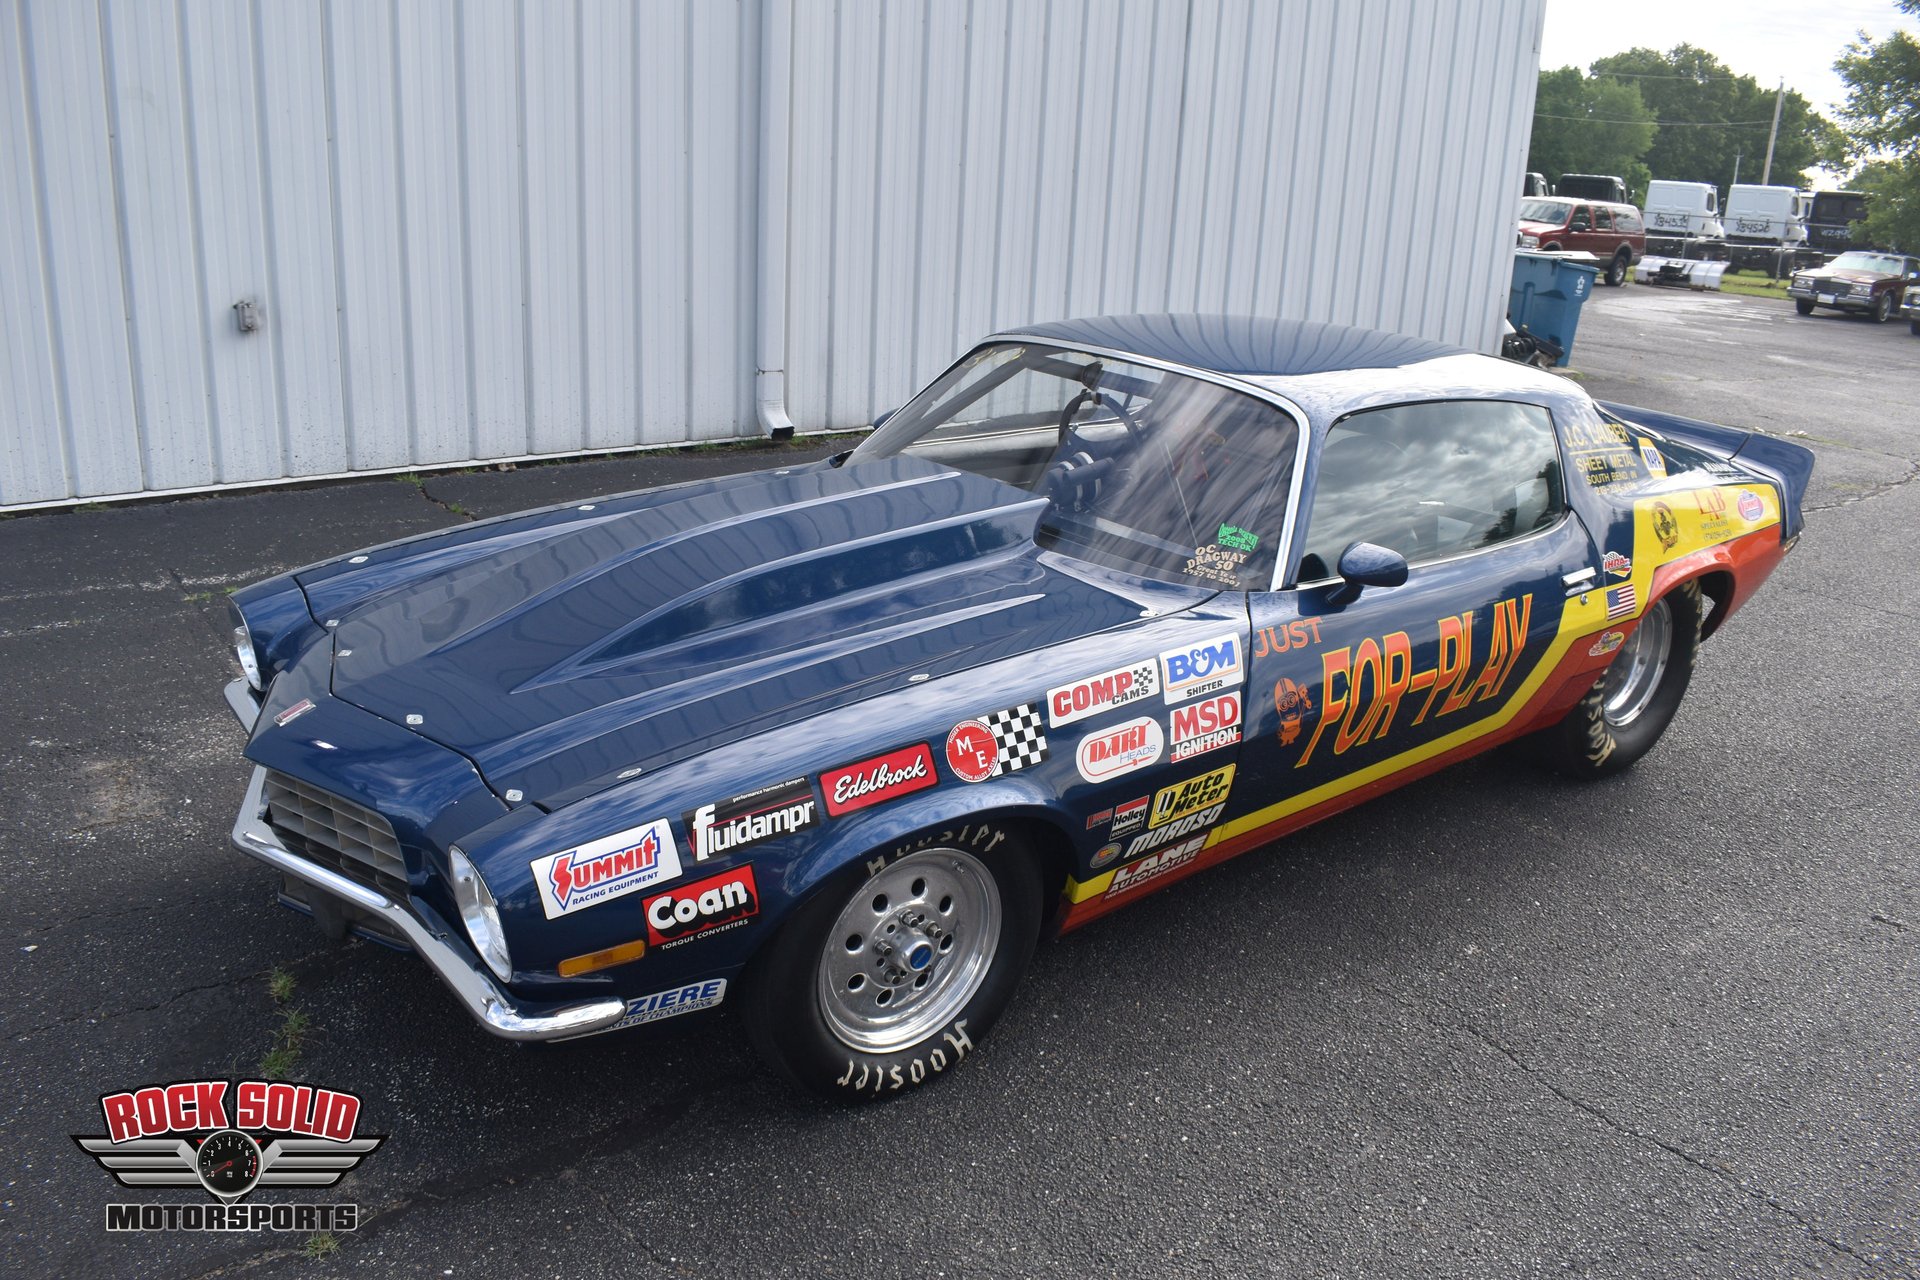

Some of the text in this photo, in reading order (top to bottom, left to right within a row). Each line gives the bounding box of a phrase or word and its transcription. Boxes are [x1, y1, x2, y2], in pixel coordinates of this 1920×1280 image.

[1575, 453, 1637, 473] SHEET METAL
[1586, 473, 1610, 485] SOUTH
[1187, 551, 1247, 569] DRAGWAY
[1195, 545, 1216, 555] OC
[1206, 572, 1216, 580] to
[1215, 561, 1234, 571] 50
[1255, 616, 1323, 658] JUST
[1166, 639, 1236, 684] B&M
[1053, 671, 1133, 718] COMP
[1111, 685, 1149, 705] CAMS
[1186, 679, 1223, 697] SHIFTER
[1294, 593, 1533, 769] FOR-PLAY
[1174, 695, 1239, 743] MSD
[955, 735, 974, 756] M
[1089, 720, 1151, 764] DART
[1119, 744, 1156, 764] HEADS
[1175, 727, 1237, 758] IGNITION
[976, 750, 988, 769] E
[833, 754, 928, 804] Edelbrock
[1179, 772, 1224, 800] Auto
[733, 790, 763, 803] performance
[1172, 783, 1229, 815] Meter
[1111, 822, 1142, 837] EQUIPPED
[1112, 806, 1146, 826] Holley
[1123, 802, 1226, 858] MOROSO
[693, 803, 815, 861] fluidampr
[1109, 848, 1200, 893] AUTOMOTIVE
[1113, 834, 1208, 884] LANE
[572, 871, 658, 905] RACING EQUIPMENT
[648, 880, 747, 930] Coan
[662, 919, 748, 950] TORQUE CONVERTERS
[626, 981, 721, 1016] ZIERE
